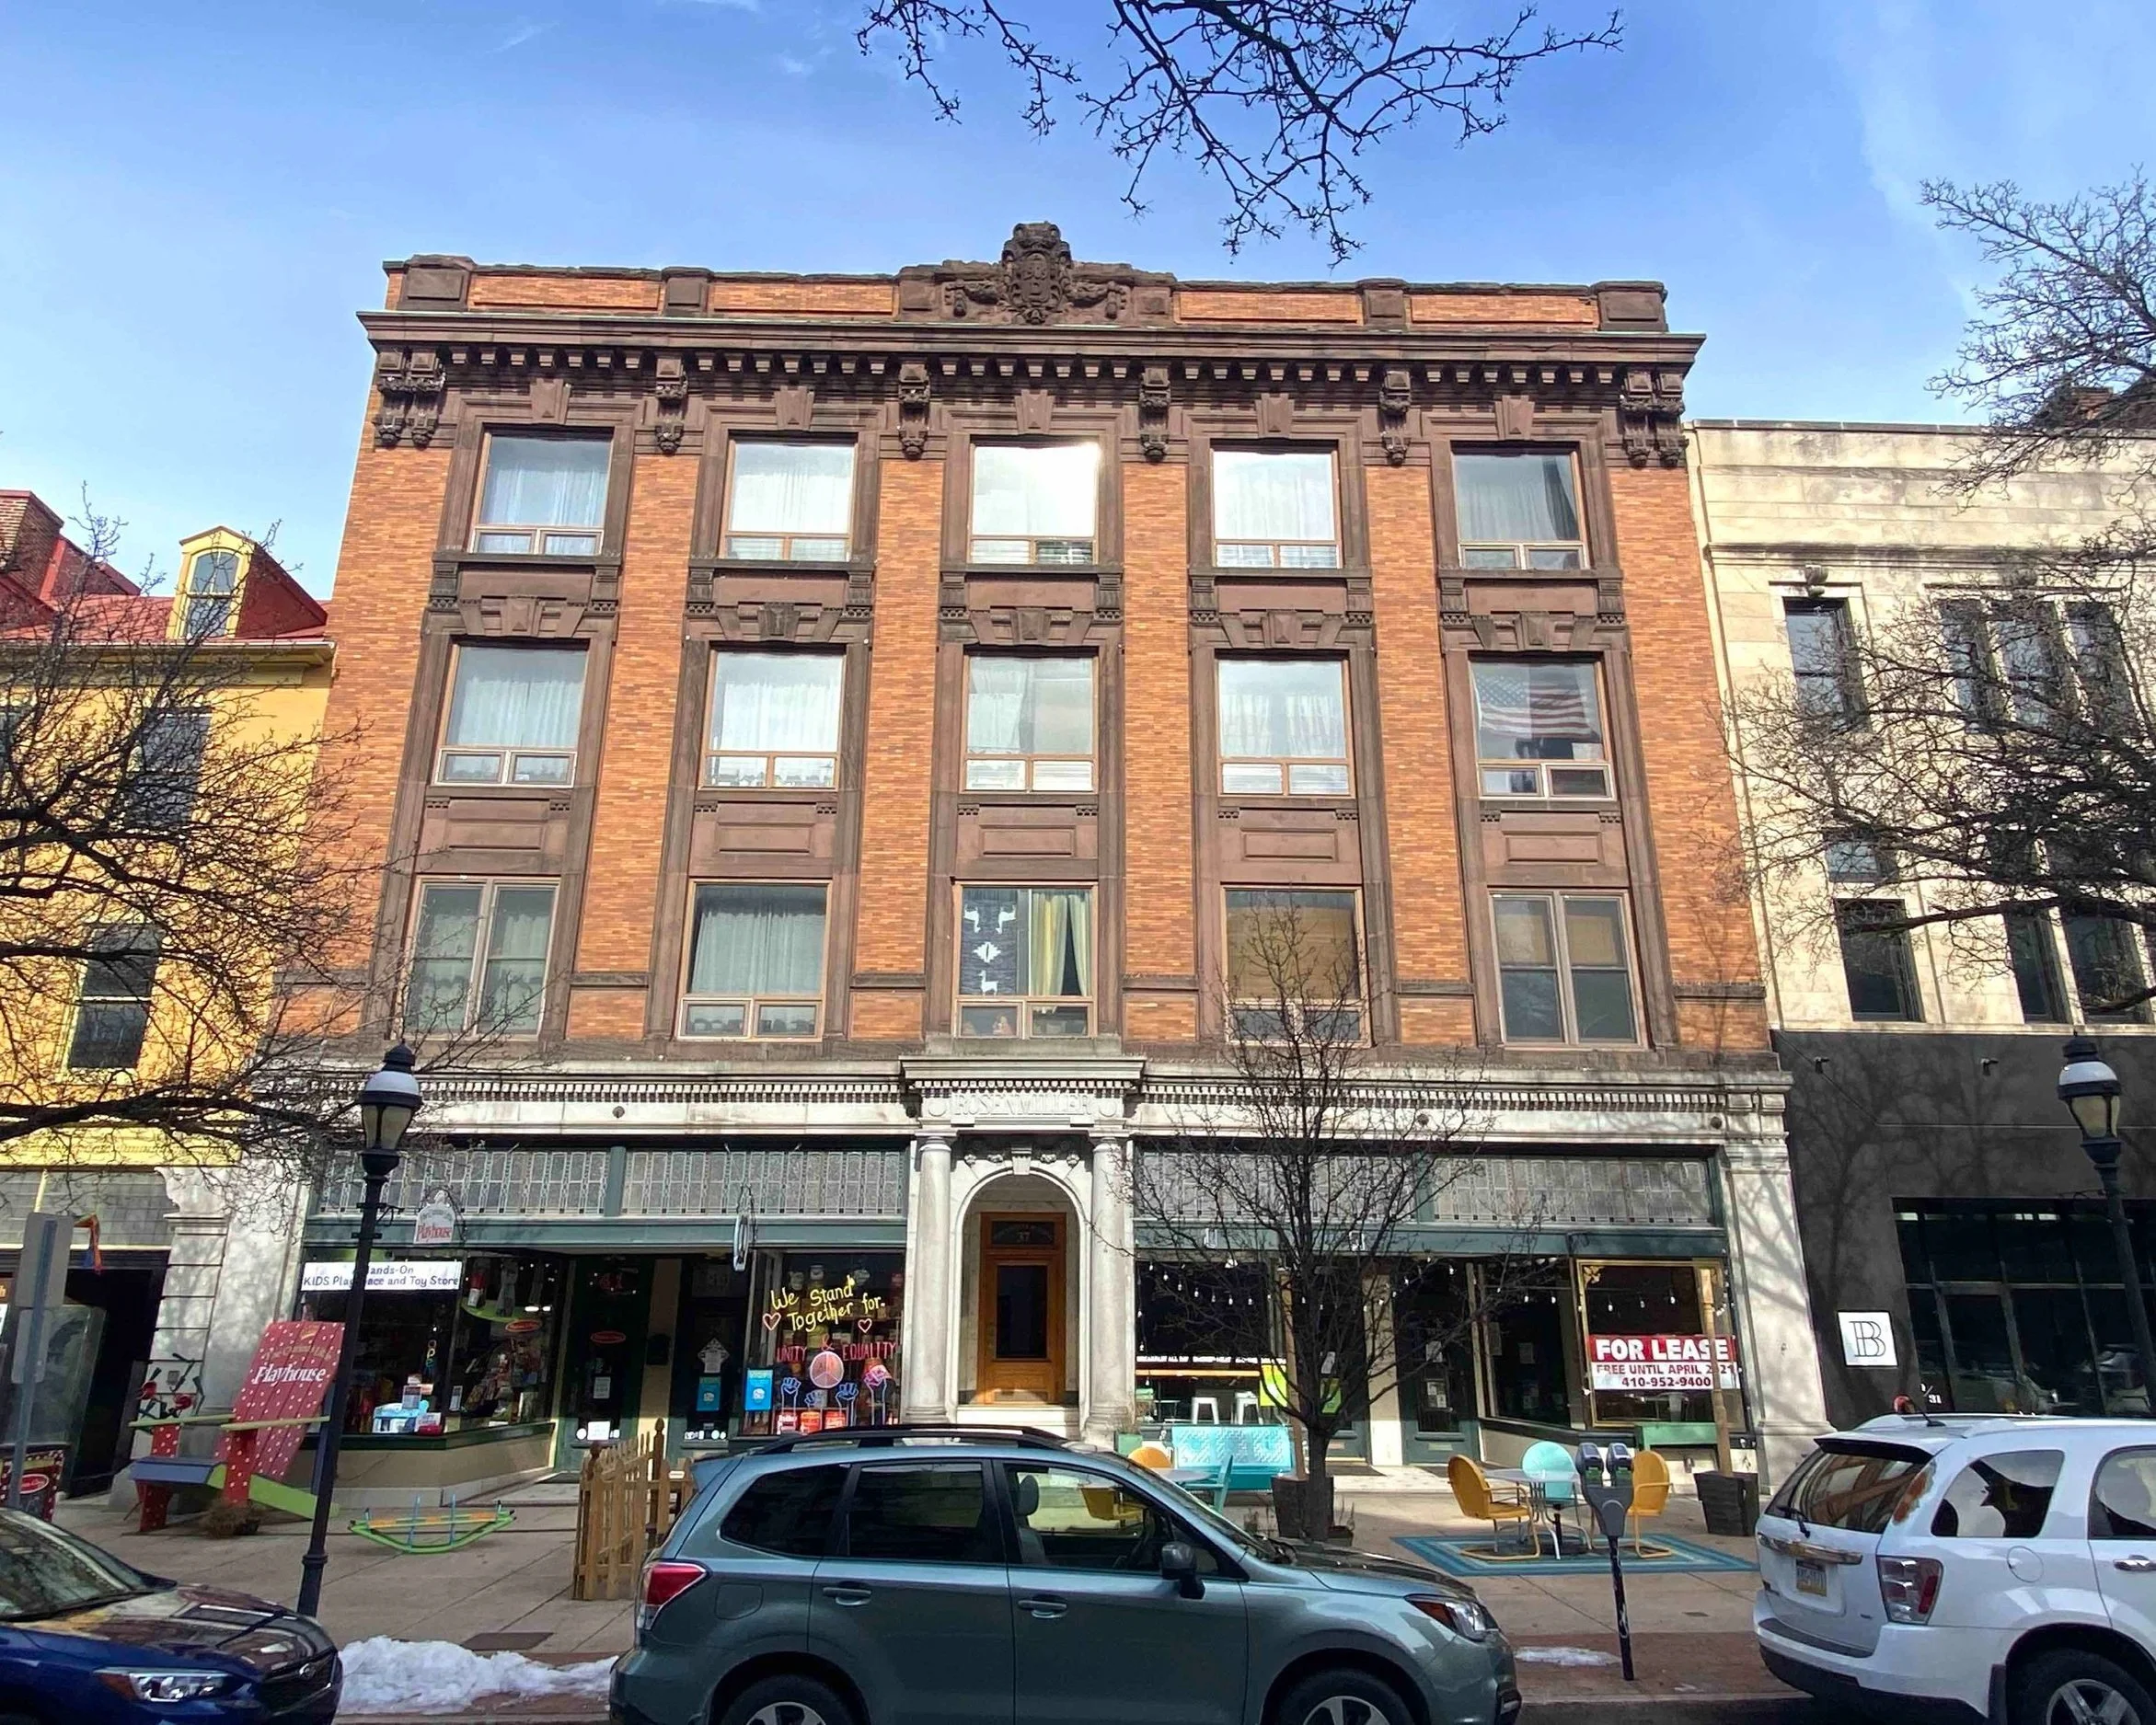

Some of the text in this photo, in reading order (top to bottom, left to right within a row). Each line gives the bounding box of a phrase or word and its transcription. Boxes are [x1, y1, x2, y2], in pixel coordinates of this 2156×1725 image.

[367, 1265, 414, 1275] ands-On
[304, 1275, 329, 1286] KIDS
[387, 1276, 406, 1286] and
[409, 1276, 427, 1288] Toy
[430, 1275, 458, 1286] Store
[771, 1287, 799, 1310] We
[810, 1275, 856, 1306] Stand
[787, 1302, 854, 1332] Together
[777, 1345, 807, 1363] UNITY
[843, 1341, 896, 1362] EQUALITY
[1595, 1338, 1729, 1361] FOR LEASE
[251, 1363, 327, 1386] Playhouse
[1597, 1364, 1735, 1374] FREE UNTIL APRIL 221
[1621, 1377, 1712, 1387] 410-952-9400
